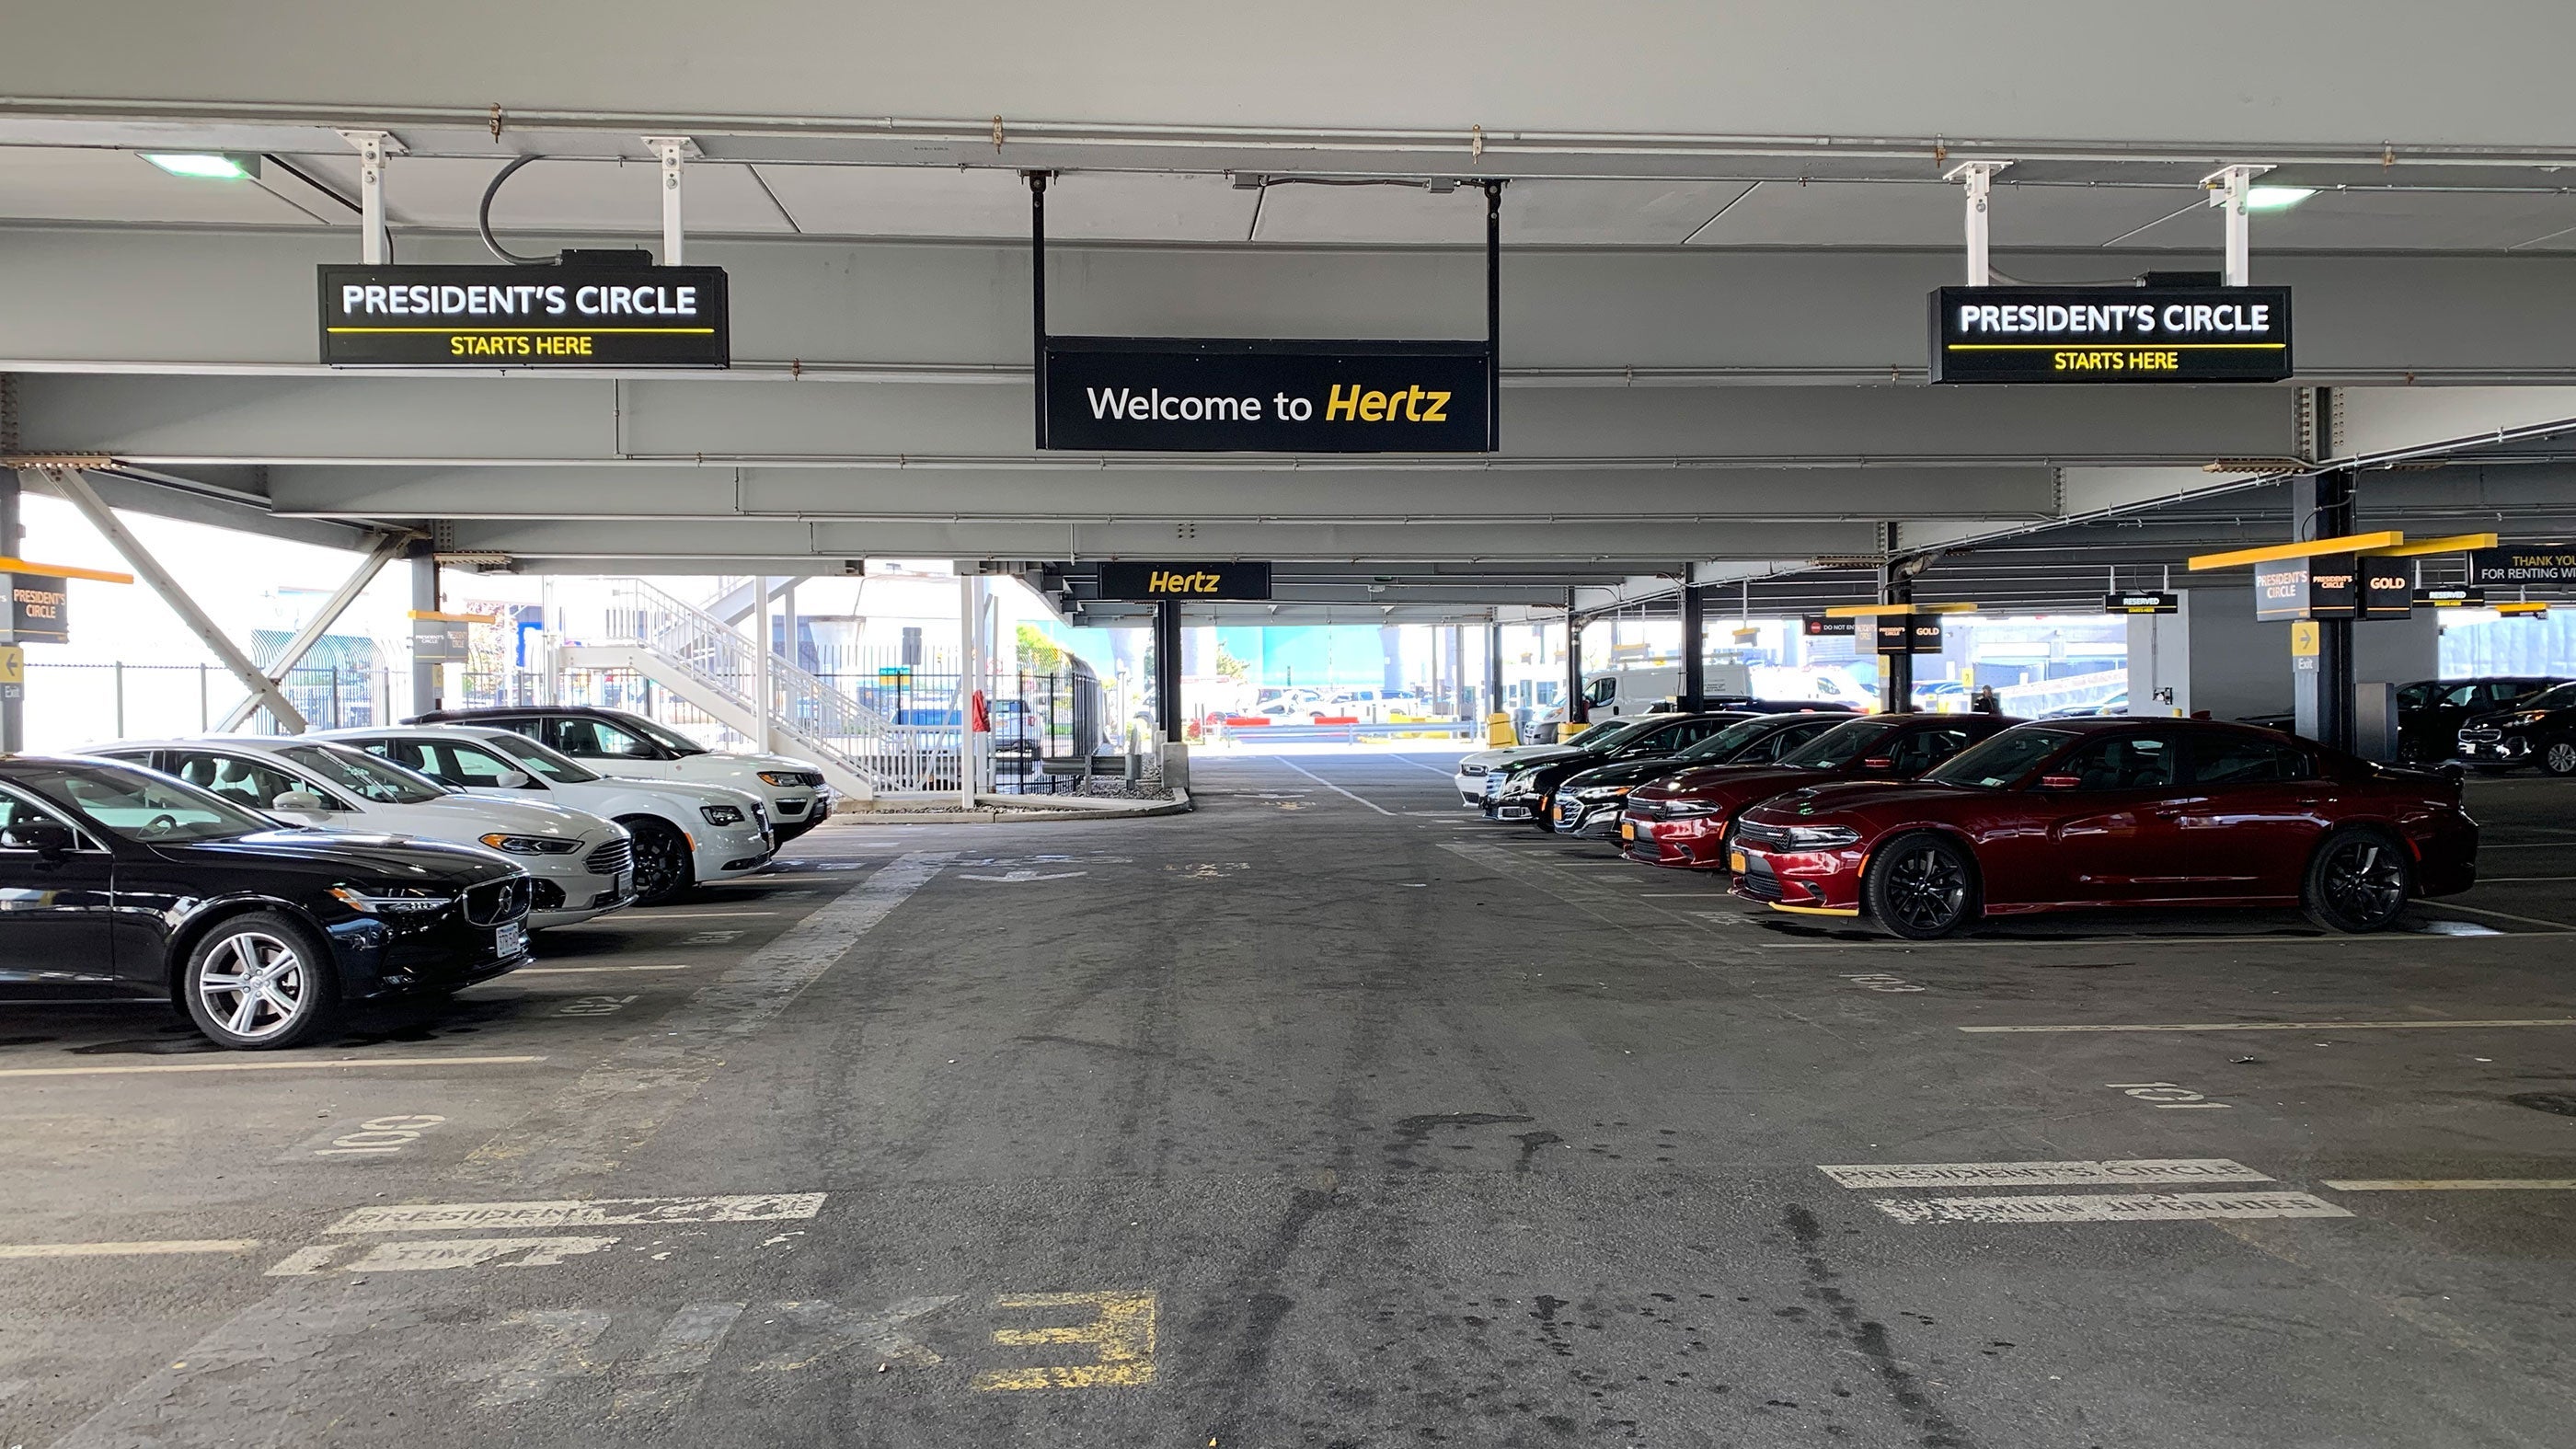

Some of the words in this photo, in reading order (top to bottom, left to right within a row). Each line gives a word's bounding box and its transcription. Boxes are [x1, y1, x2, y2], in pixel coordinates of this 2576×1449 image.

[342, 285, 566, 315] PRESIDENT'S
[576, 286, 697, 315] CIRCLE
[1961, 305, 2156, 333] PRESIDENT'S
[2163, 305, 2270, 332] CIRCLE
[451, 336, 530, 355] STARTS
[536, 337, 592, 355] HERE
[2054, 351, 2123, 370] STARTS
[2130, 351, 2179, 370] HERE
[1087, 386, 1261, 421] Welcome
[1273, 390, 1312, 421] to
[1326, 384, 1452, 422] Hertz
[2513, 556, 2552, 567] THANK
[1148, 571, 1221, 592] Hertz
[2257, 570, 2307, 587] PRESIDENT'S
[2481, 569, 2504, 579] FOR
[2508, 568, 2558, 579] RENTING
[2267, 585, 2296, 598] CIRCLE
[2370, 577, 2406, 590] GOLD
[13, 589, 65, 605] PRESIDENT'S
[2122, 597, 2160, 605] RESERVED
[2429, 591, 2467, 599] RESERVED
[26, 604, 56, 619] CIRCLE
[1916, 627, 1940, 636] GOLD
[2298, 658, 2313, 670] Exit
[1839, 973, 1926, 992] 103
[550, 995, 639, 1018] 102
[2105, 1081, 2233, 1109] 101
[315, 1114, 446, 1156] 100
[2104, 1165, 2252, 1177] CIRCLE
